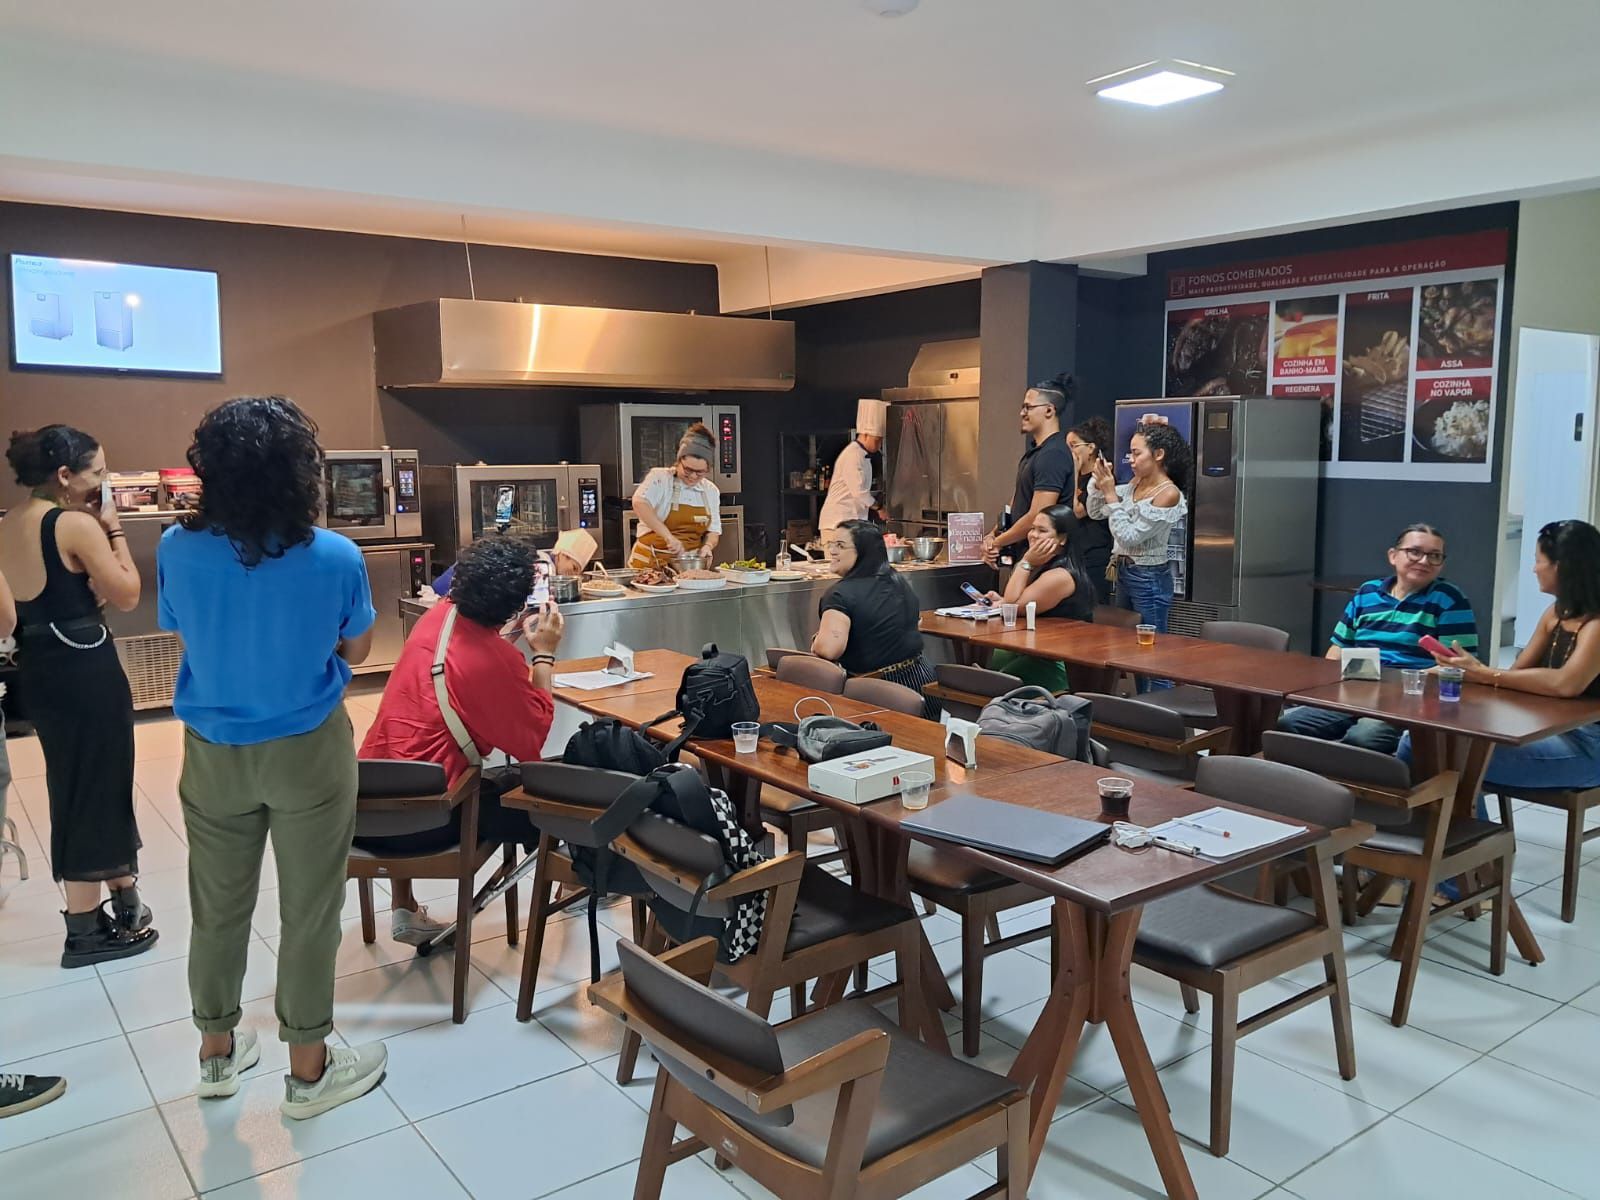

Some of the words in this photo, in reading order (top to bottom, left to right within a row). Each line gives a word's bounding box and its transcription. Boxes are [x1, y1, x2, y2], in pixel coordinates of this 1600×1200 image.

[1188, 274, 1225, 285] FORNOS
[1226, 265, 1293, 281] COMBINADOS
[1262, 277, 1300, 288] QUALIDADE
[1309, 270, 1366, 282] VERSATILIDADE
[1369, 266, 1391, 275] PARA
[1401, 260, 1447, 272] OPERAÇÃO
[1367, 291, 1390, 301] FRITA
[1205, 308, 1229, 316] GRELHA
[1283, 359, 1313, 368] COZINHA
[1314, 358, 1326, 366] EM
[1440, 359, 1464, 368] ASSA
[1279, 366, 1329, 375] BANHO-MARIA
[1433, 379, 1471, 389] COZINHA
[1285, 385, 1320, 393] REGENERA
[1430, 389, 1443, 397] NO
[1444, 388, 1473, 397] VAPOR
